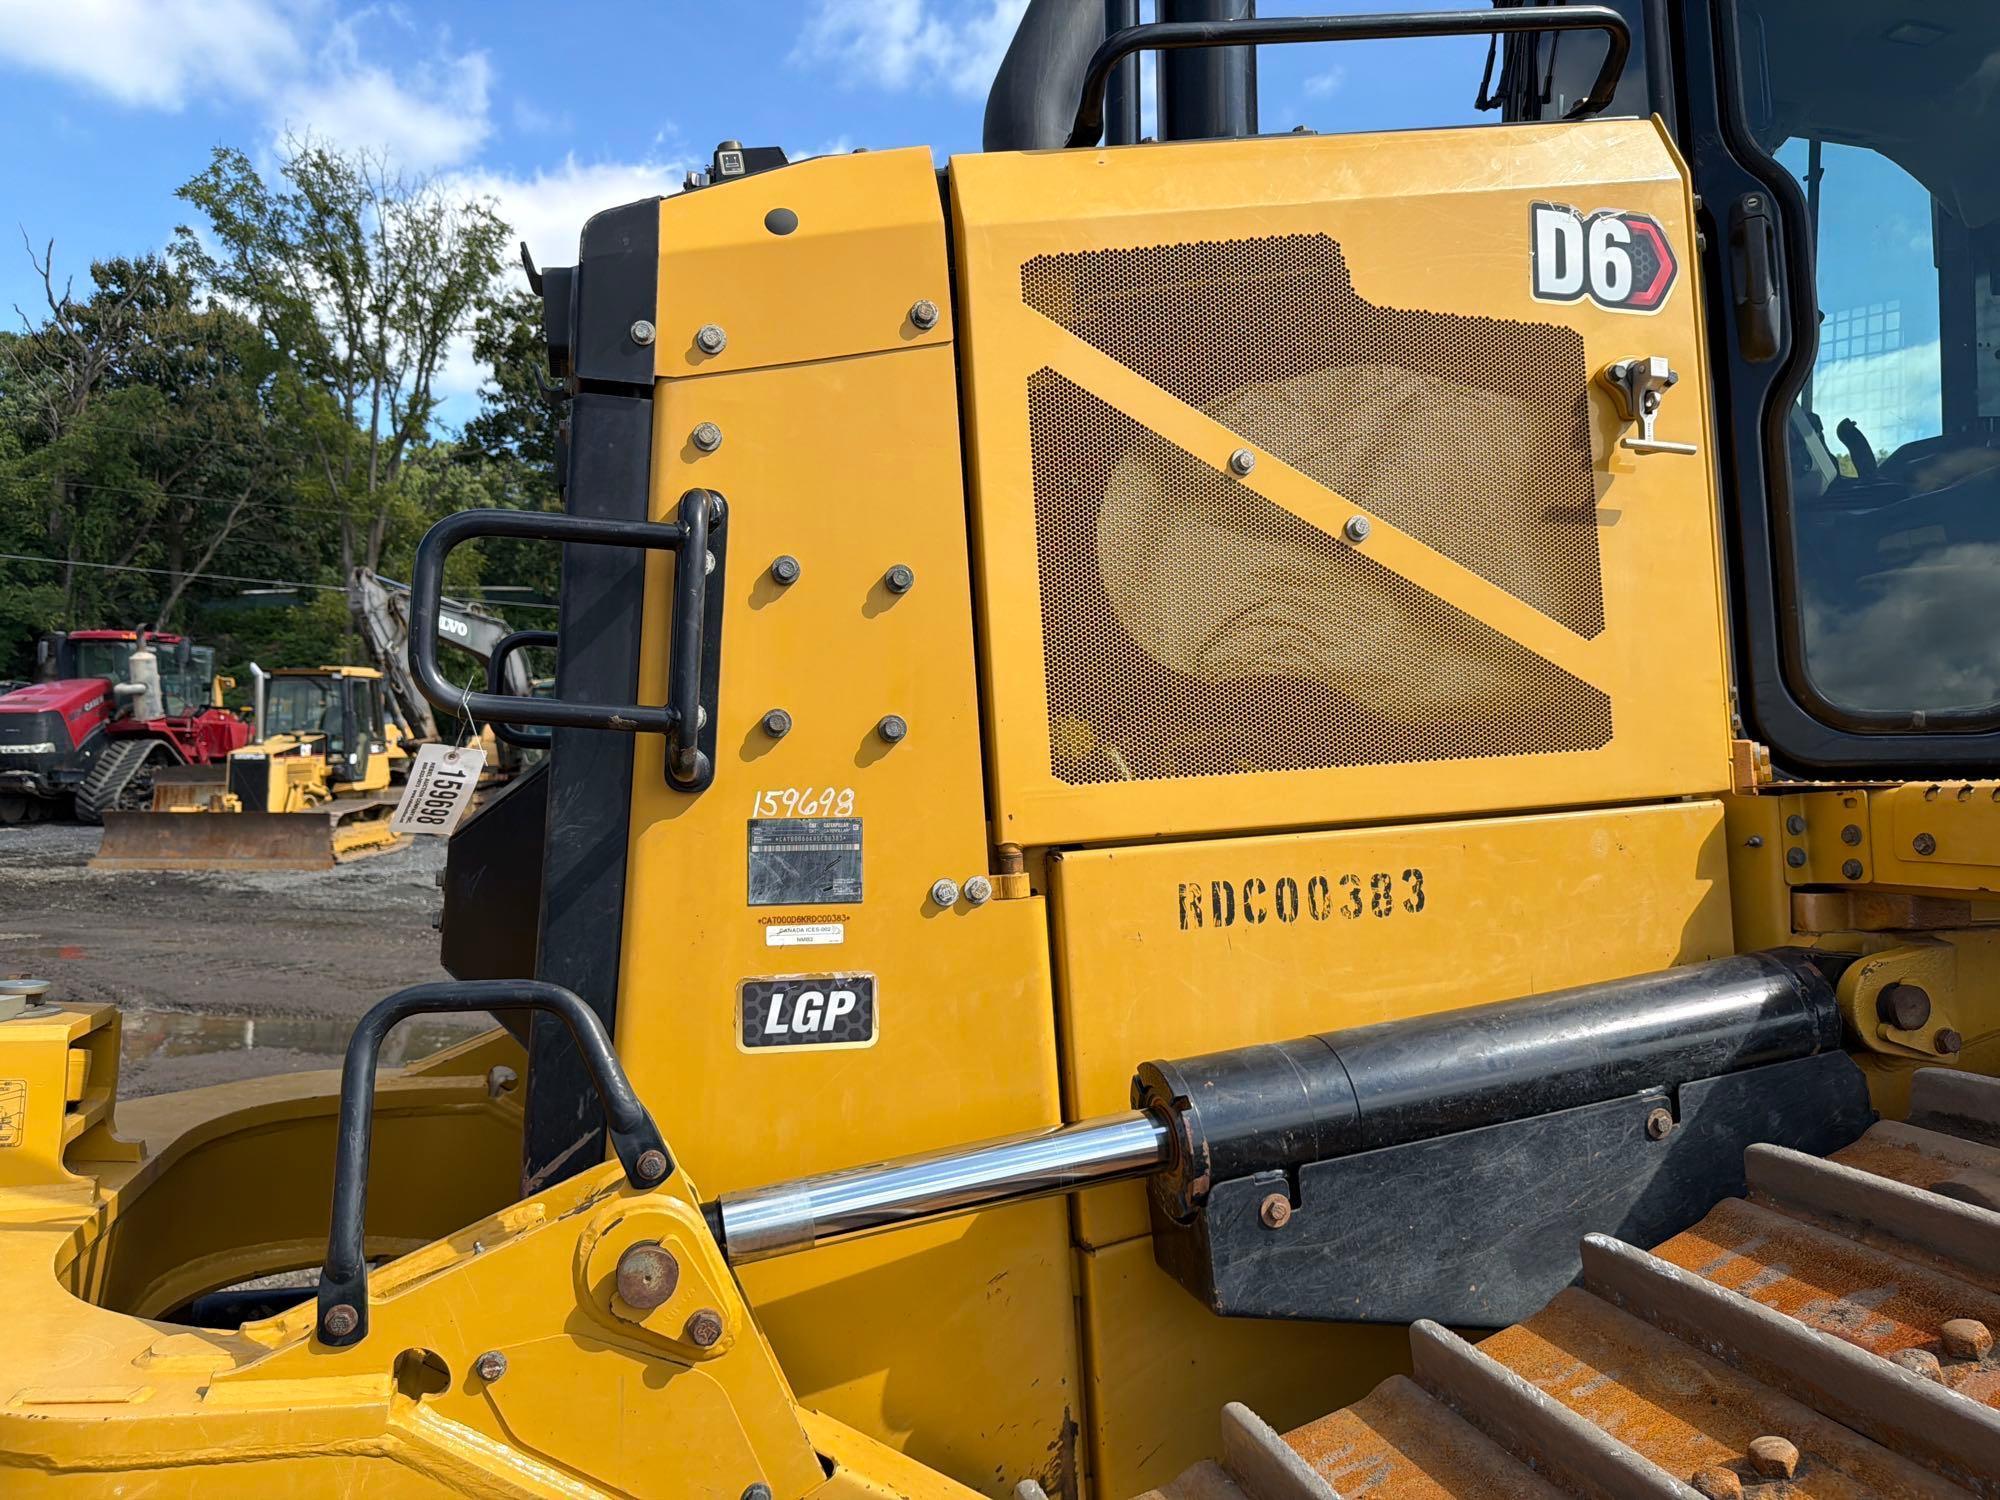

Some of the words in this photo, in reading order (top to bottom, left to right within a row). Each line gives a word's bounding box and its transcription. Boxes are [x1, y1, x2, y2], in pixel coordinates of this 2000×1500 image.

[1536, 208, 1632, 302] D6
[439, 614, 468, 637] LVO
[426, 762, 436, 777] REBEL
[416, 770, 467, 825] 159698
[418, 777, 430, 797] AUCTION
[752, 787, 855, 818] 159698
[410, 797, 422, 816] COMPANY
[1178, 868, 1426, 930] RDC00383
[764, 990, 857, 1035] LGP
